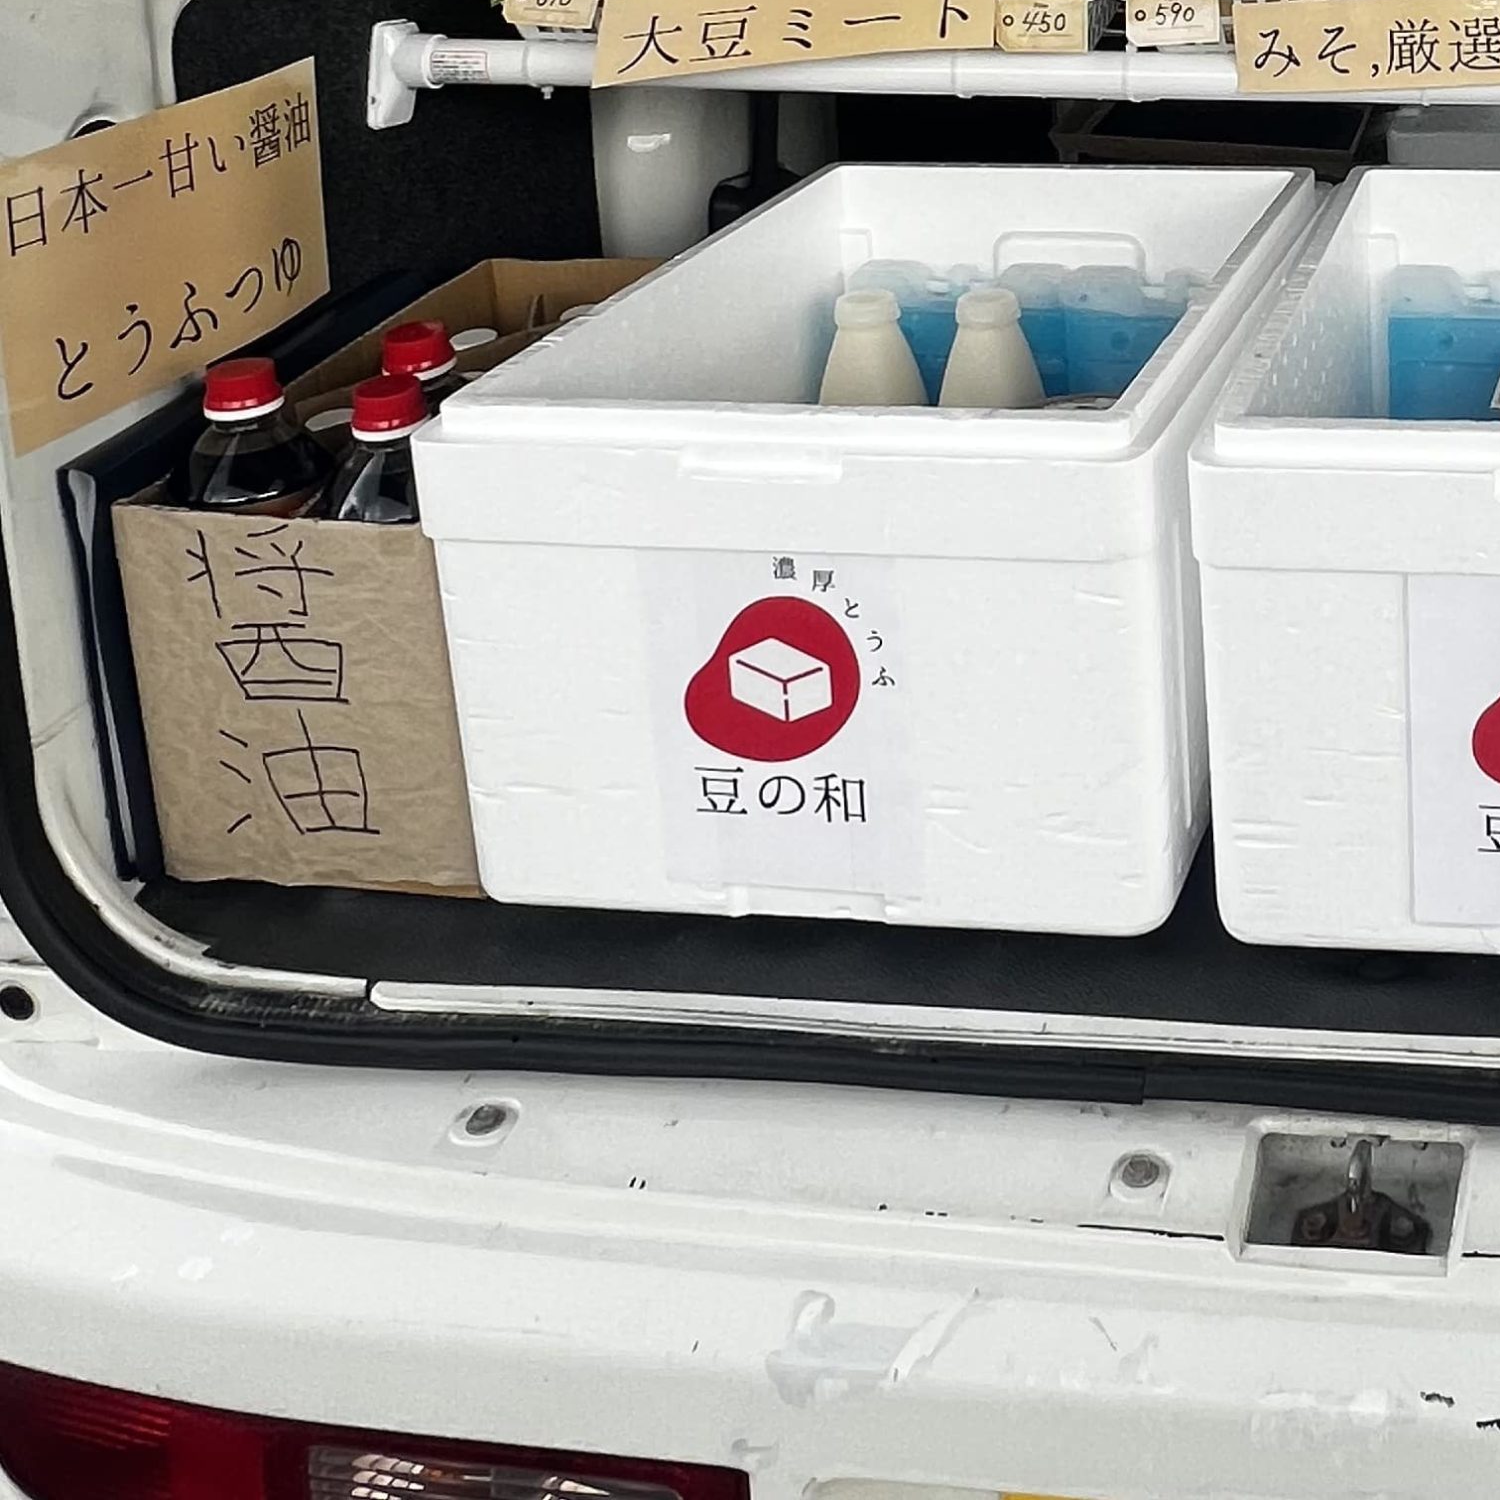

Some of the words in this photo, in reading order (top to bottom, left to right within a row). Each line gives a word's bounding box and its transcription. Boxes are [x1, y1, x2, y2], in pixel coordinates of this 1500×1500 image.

[1023, 12, 1065, 33] 450
[1156, 3, 1194, 26] 590
[5, 91, 313, 259] 日本一甘い醤油
[55, 237, 303, 401] とうふつゆ
[187, 522, 380, 836] 醤油
[772, 557, 895, 687] 濃厚とうふ
[694, 767, 867, 823] 豆の和
